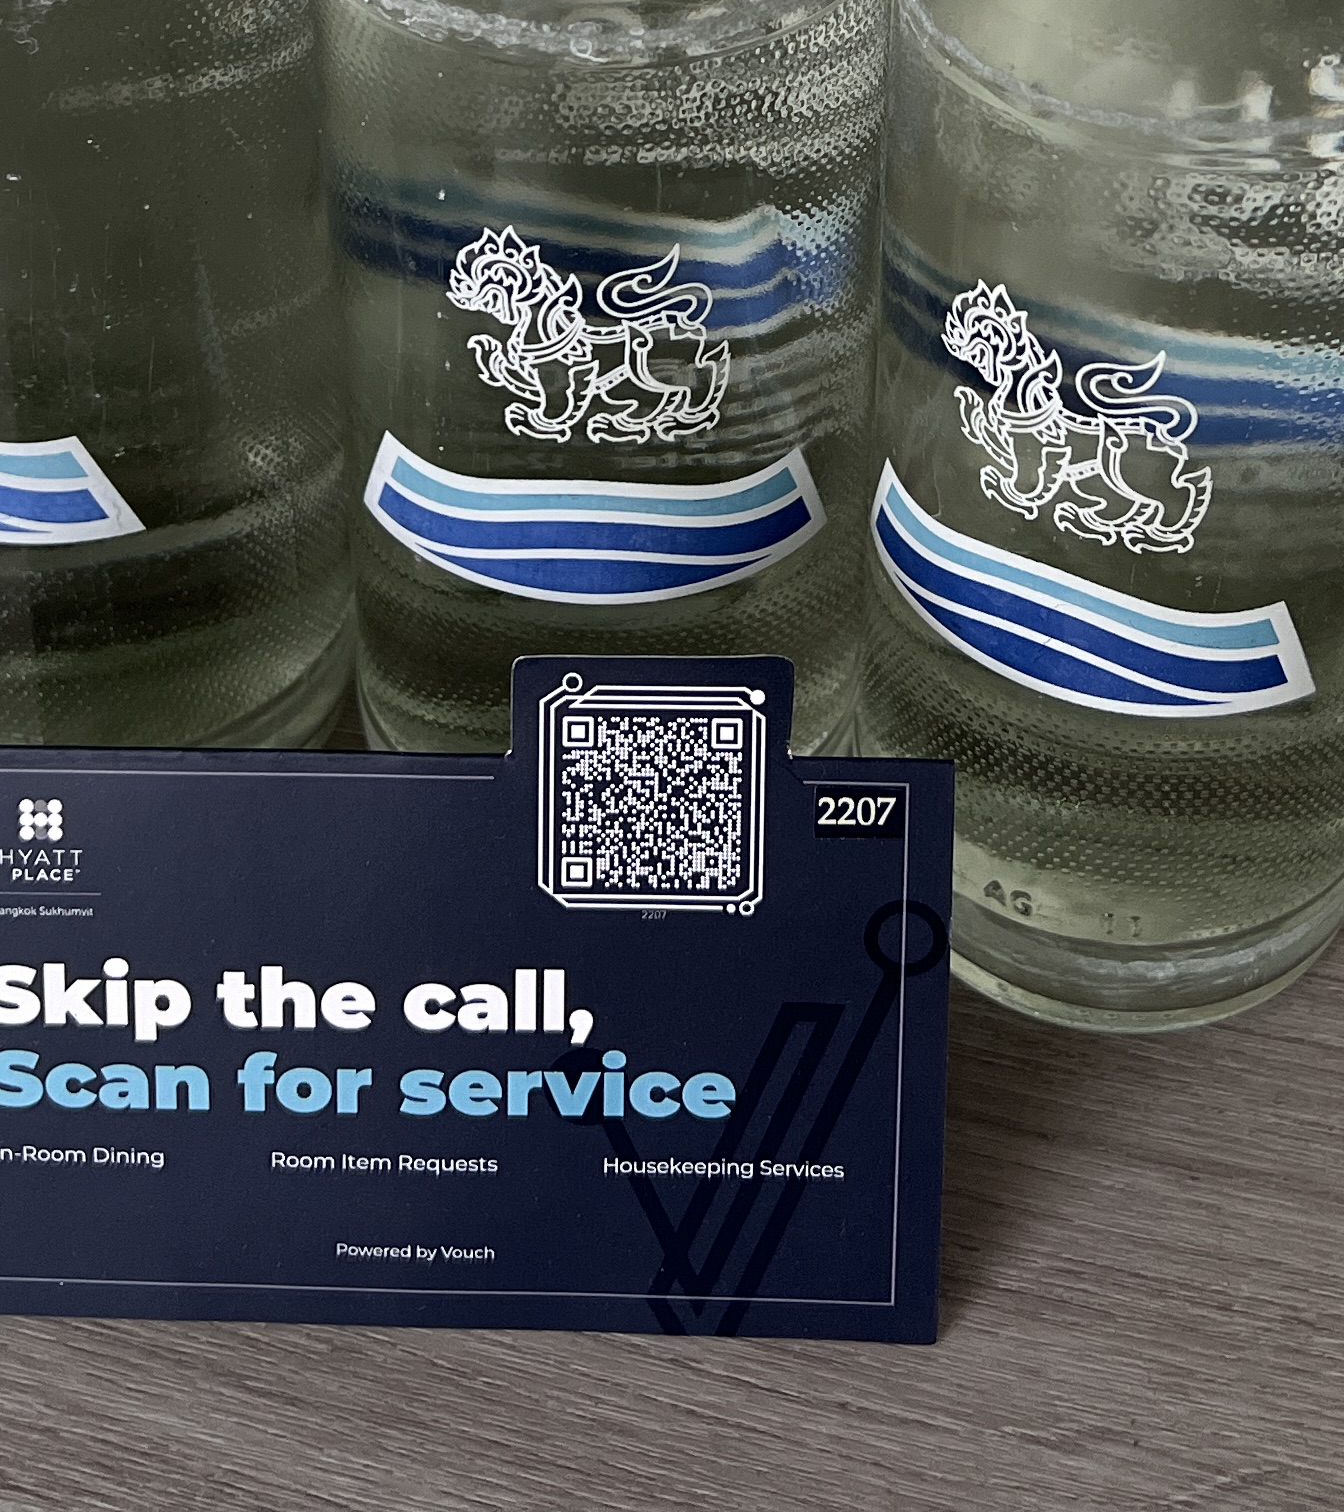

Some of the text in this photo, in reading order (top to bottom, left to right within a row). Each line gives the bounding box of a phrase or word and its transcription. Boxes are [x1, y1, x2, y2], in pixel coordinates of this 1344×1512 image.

[817, 796, 897, 826] 2207
[0, 848, 83, 866] HYATT
[12, 868, 74, 882] PLACE
[39, 905, 94, 918] Sukhumvit
[216, 965, 376, 1030] the
[403, 968, 594, 1045] call,
[237, 1051, 373, 1114] for
[399, 1049, 736, 1119] service
[93, 1146, 165, 1169] Dining
[271, 1151, 498, 1176] Room Item Requests
[603, 1157, 845, 1179] Housekeeping Services
[336, 1242, 496, 1262] Powered by Vouch
